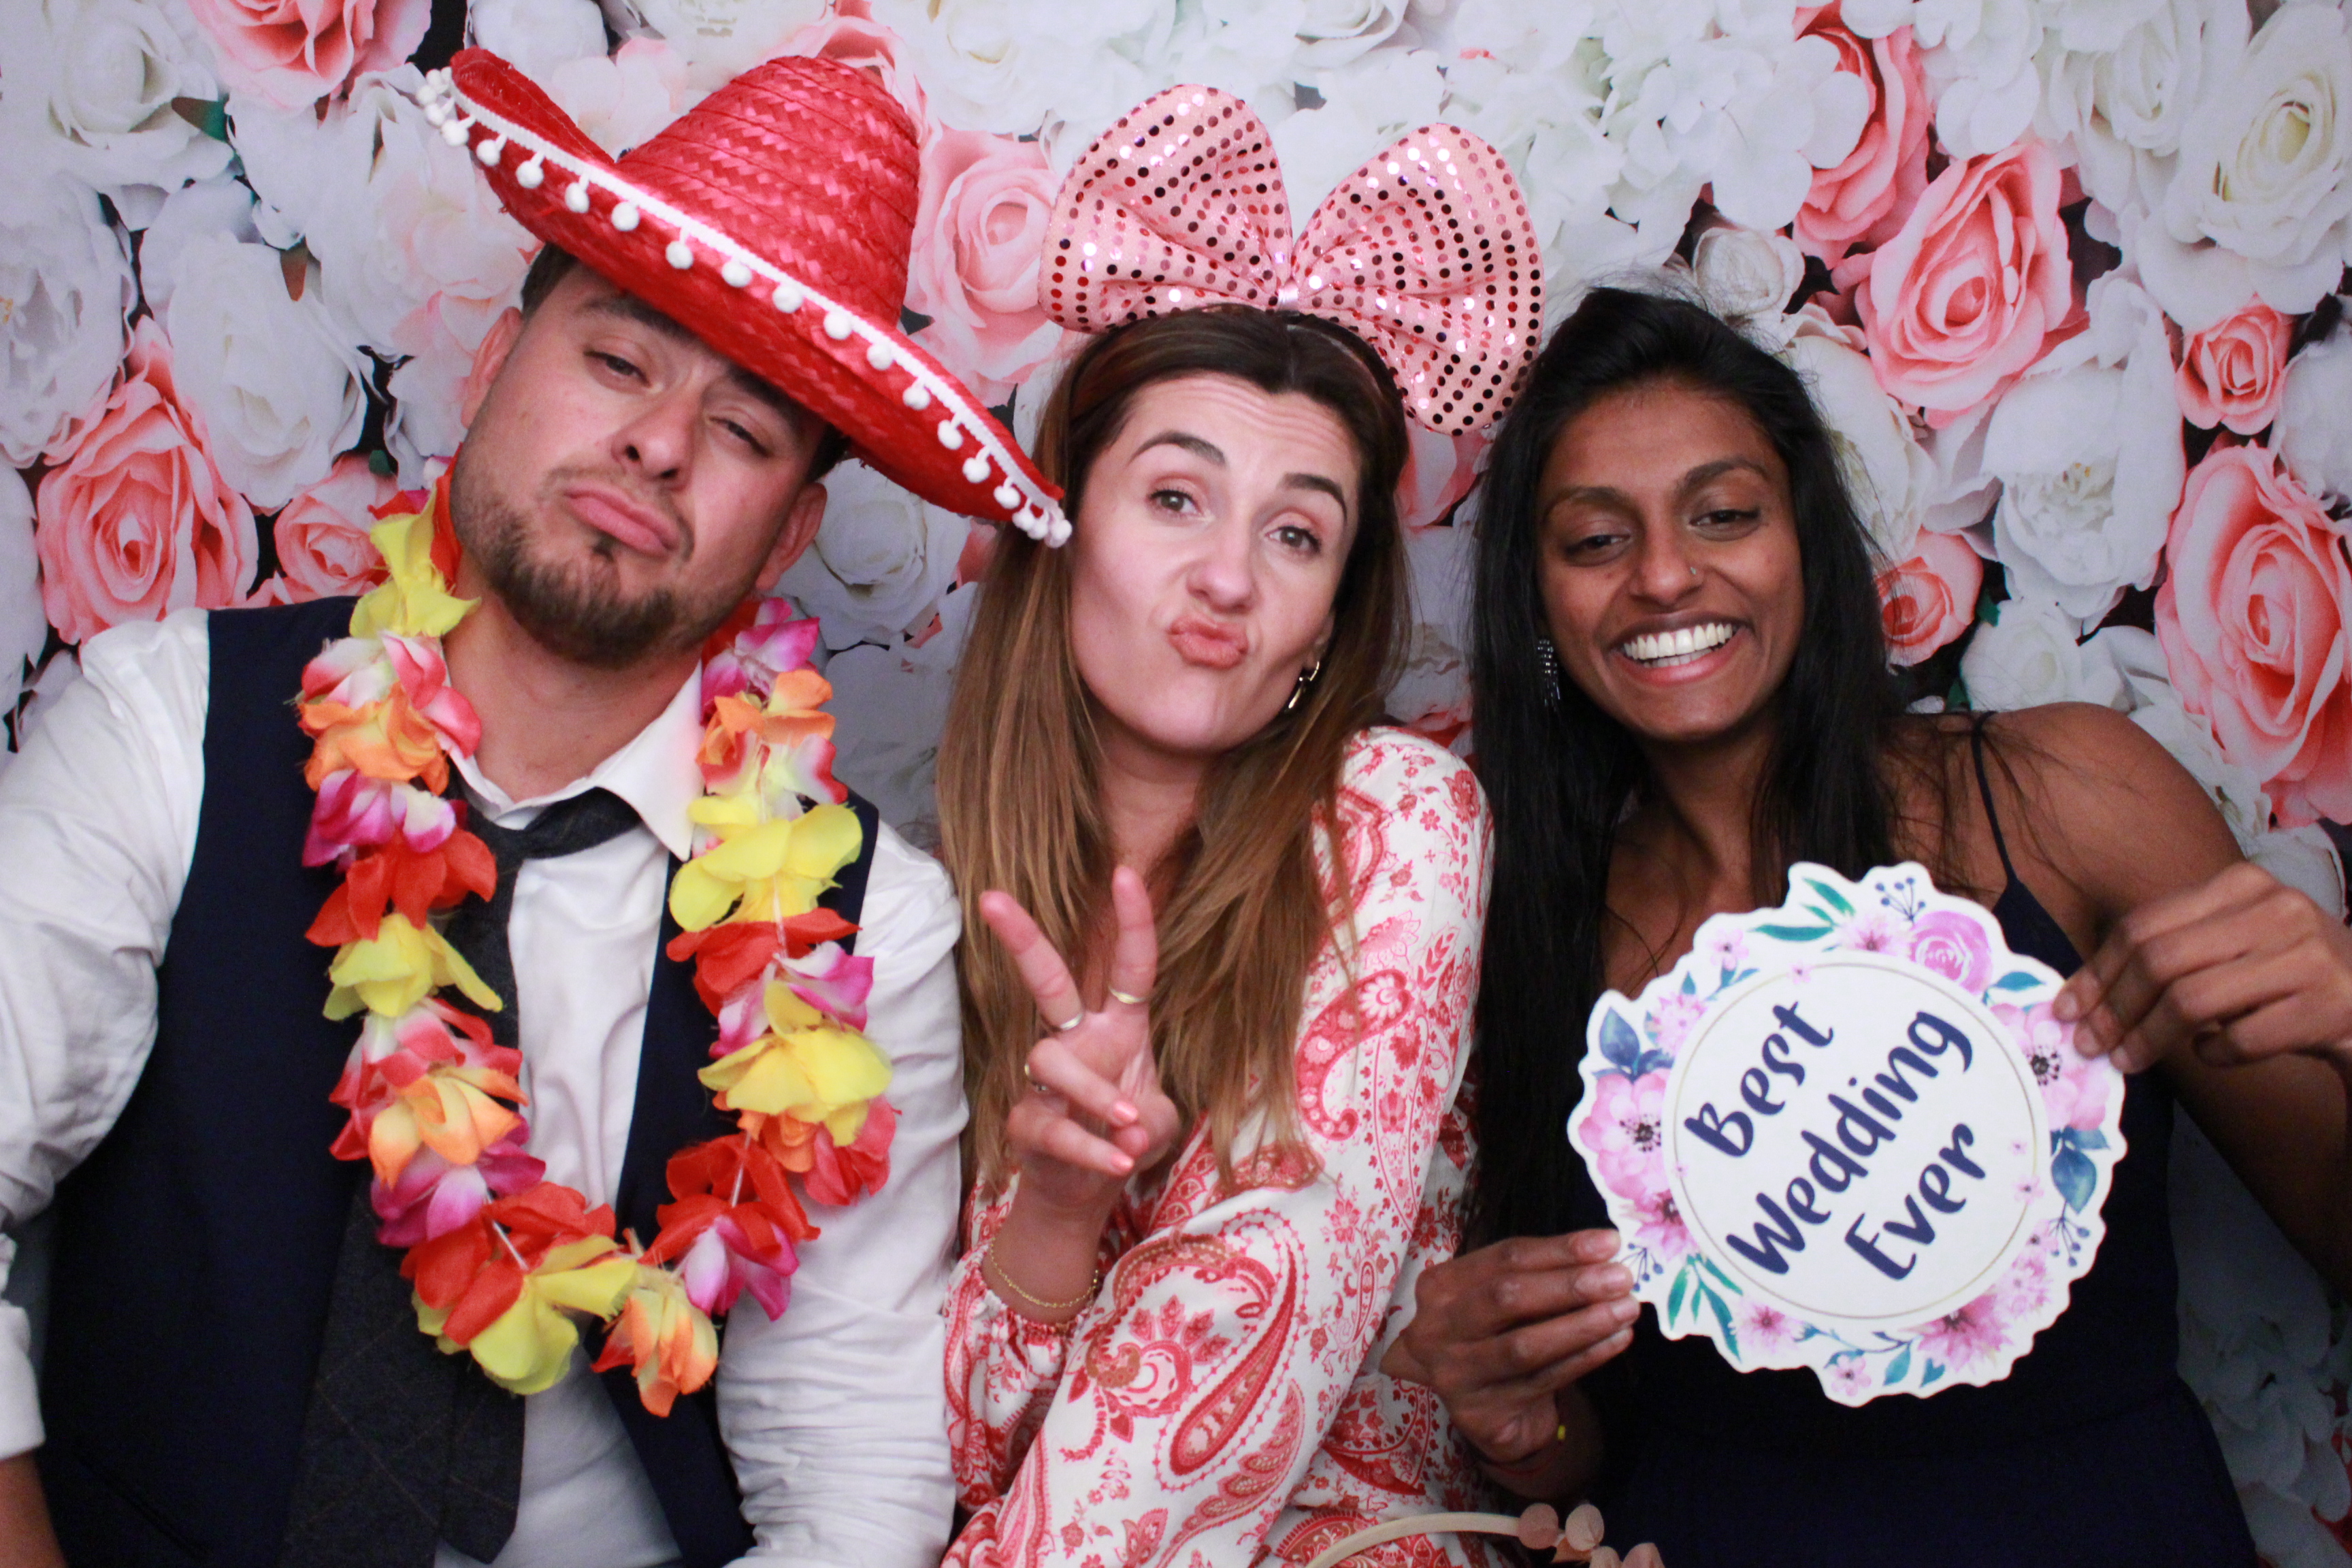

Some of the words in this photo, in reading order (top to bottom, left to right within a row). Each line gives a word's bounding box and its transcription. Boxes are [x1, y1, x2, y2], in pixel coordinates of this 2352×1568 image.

[1684, 1002, 1833, 1157] Best
[1726, 1011, 1973, 1275] Wedding
[1844, 1123, 1987, 1280] Ever
